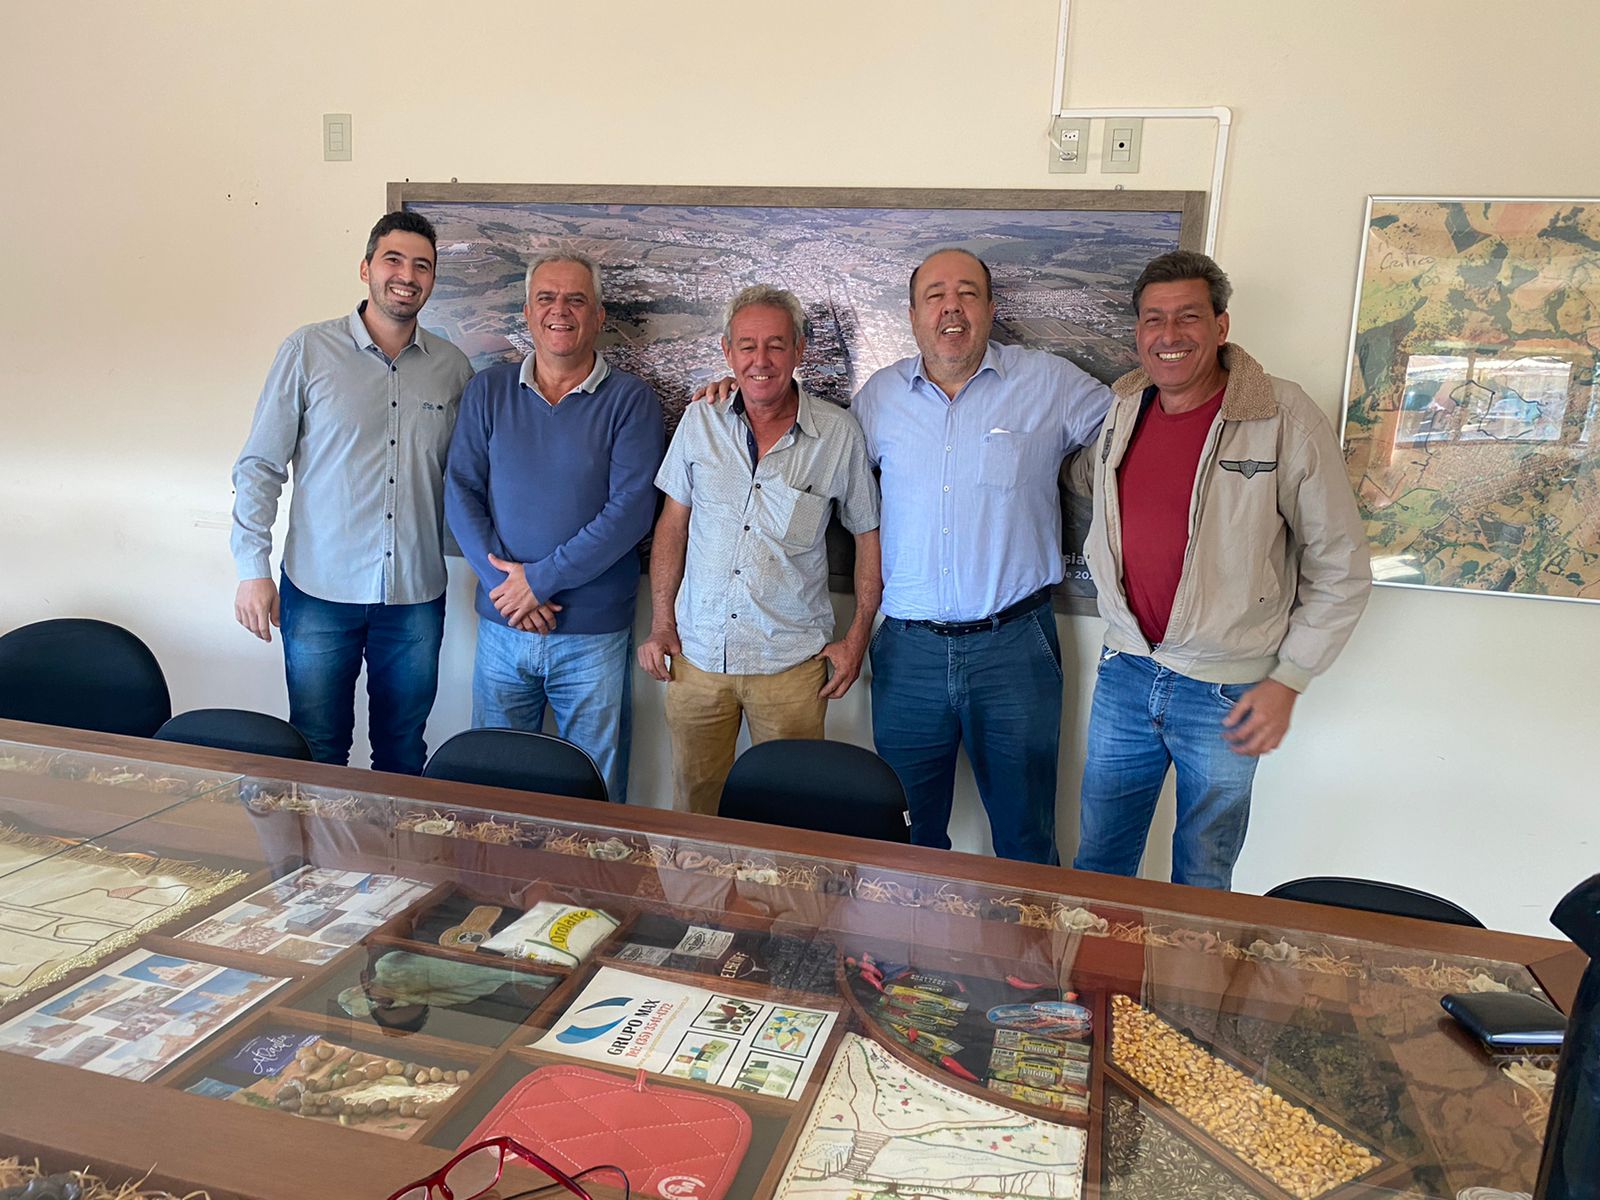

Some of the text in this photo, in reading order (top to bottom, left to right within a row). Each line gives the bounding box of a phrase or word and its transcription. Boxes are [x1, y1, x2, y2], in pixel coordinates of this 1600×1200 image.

[1063, 553, 1085, 565] sia
[1075, 570, 1093, 580] 20
[607, 998, 660, 1055] GRUPO MAX
